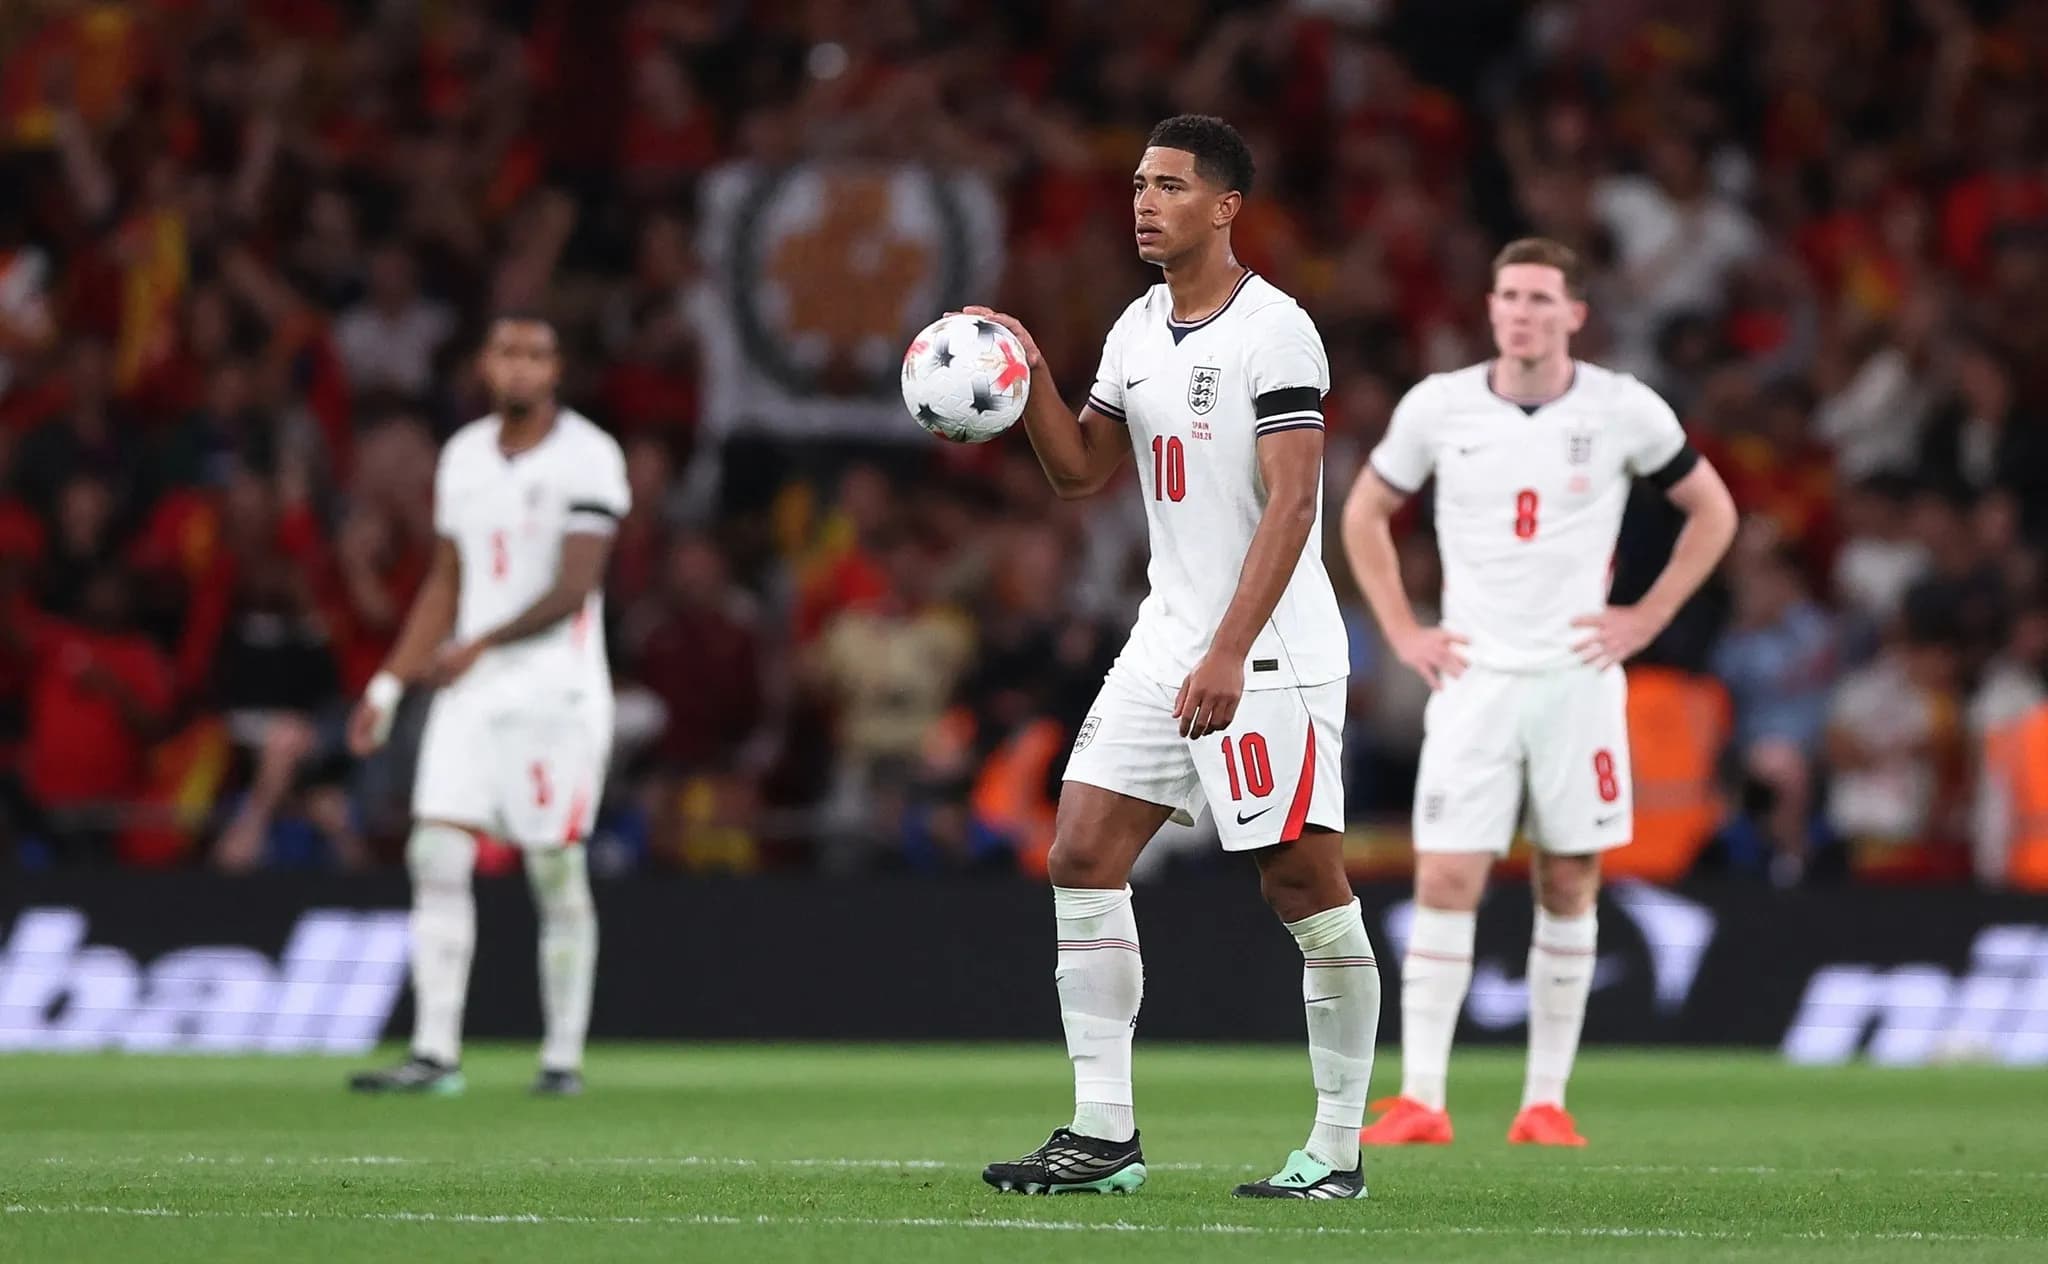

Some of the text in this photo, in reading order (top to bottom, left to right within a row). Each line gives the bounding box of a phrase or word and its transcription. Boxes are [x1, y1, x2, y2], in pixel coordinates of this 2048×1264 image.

[1151, 434, 1186, 502] 10
[1515, 488, 1538, 541] 8
[1221, 732, 1274, 801] 10
[1594, 749, 1618, 803] 8
[0, 906, 413, 1054] ball
